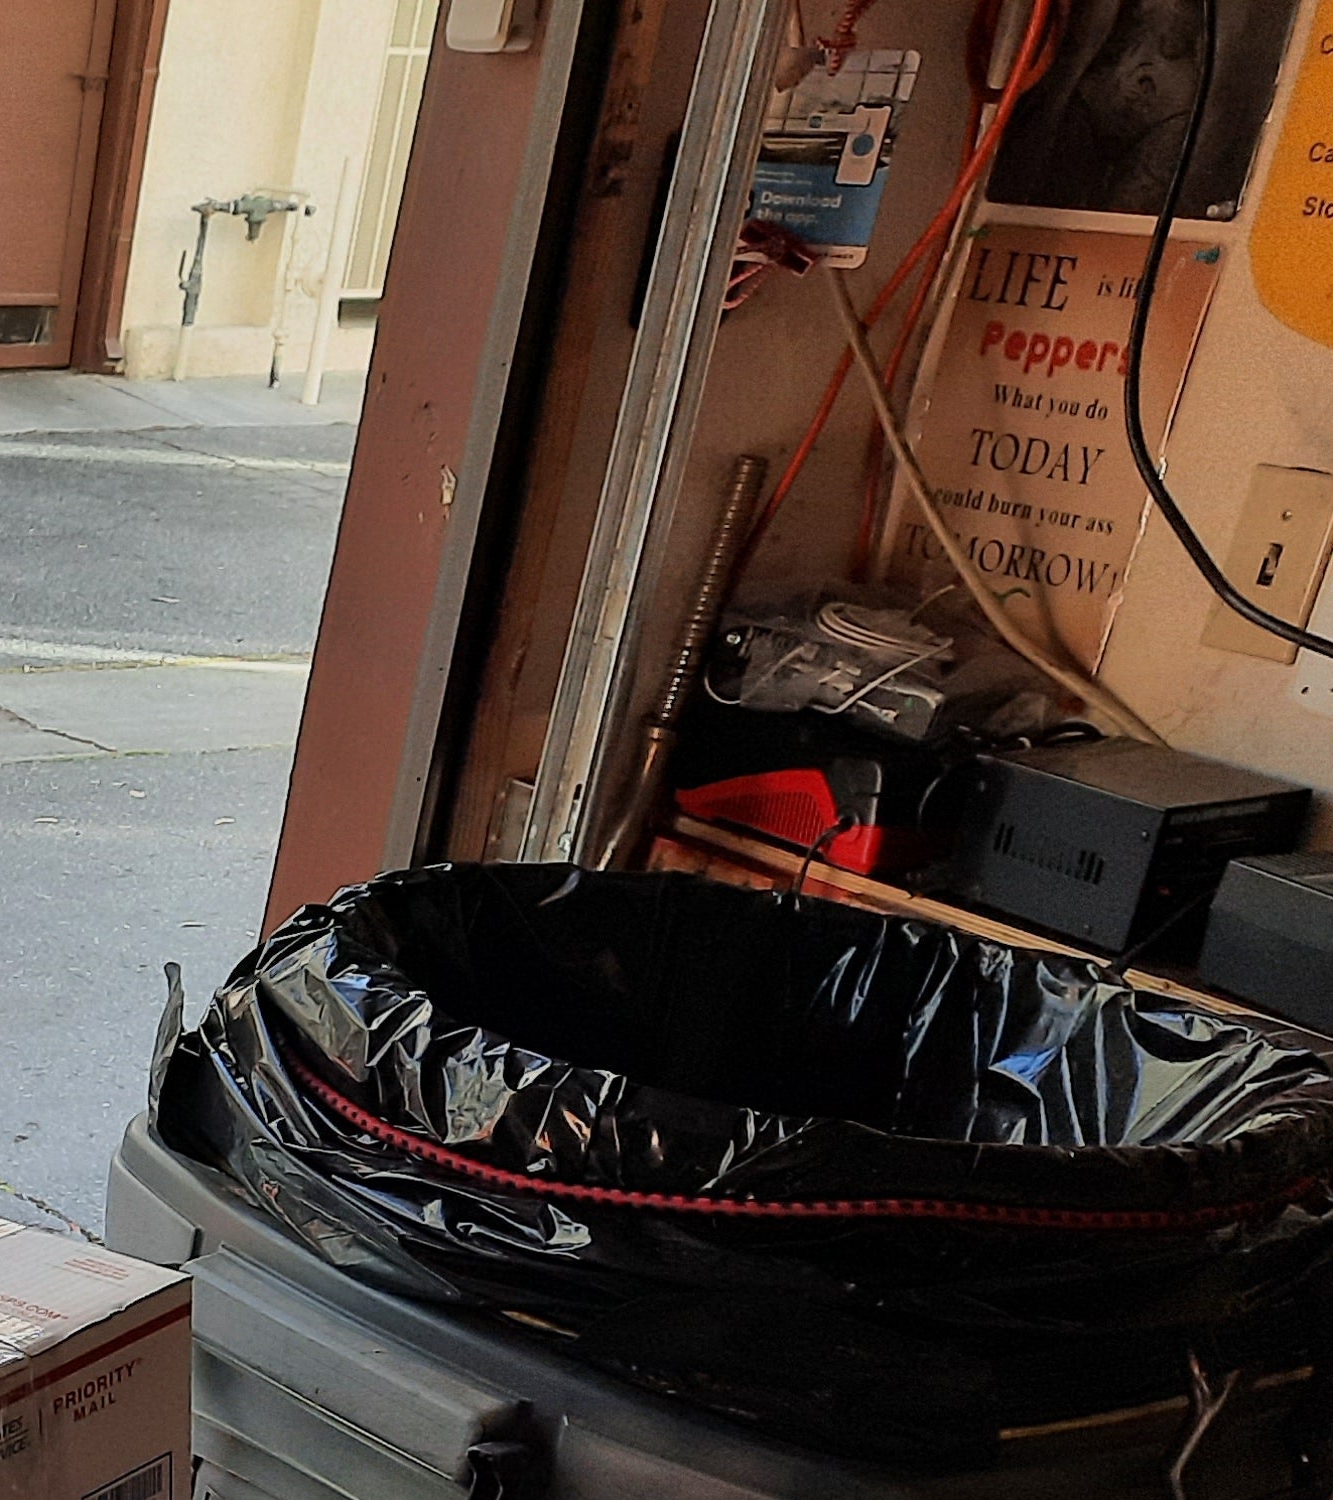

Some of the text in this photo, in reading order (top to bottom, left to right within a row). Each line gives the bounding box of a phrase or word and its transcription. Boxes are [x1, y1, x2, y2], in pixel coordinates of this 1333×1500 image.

[760, 191, 842, 208] Download
[969, 248, 1078, 312] LIFE
[1096, 274, 1113, 297] is
[979, 319, 1130, 378] Peppers
[994, 383, 1109, 421] What you do
[970, 427, 1106, 486] TODAY
[933, 487, 1116, 536] could burn your ass
[52, 1359, 136, 1416] PRIORITY
[73, 1391, 117, 1424] MAIL
